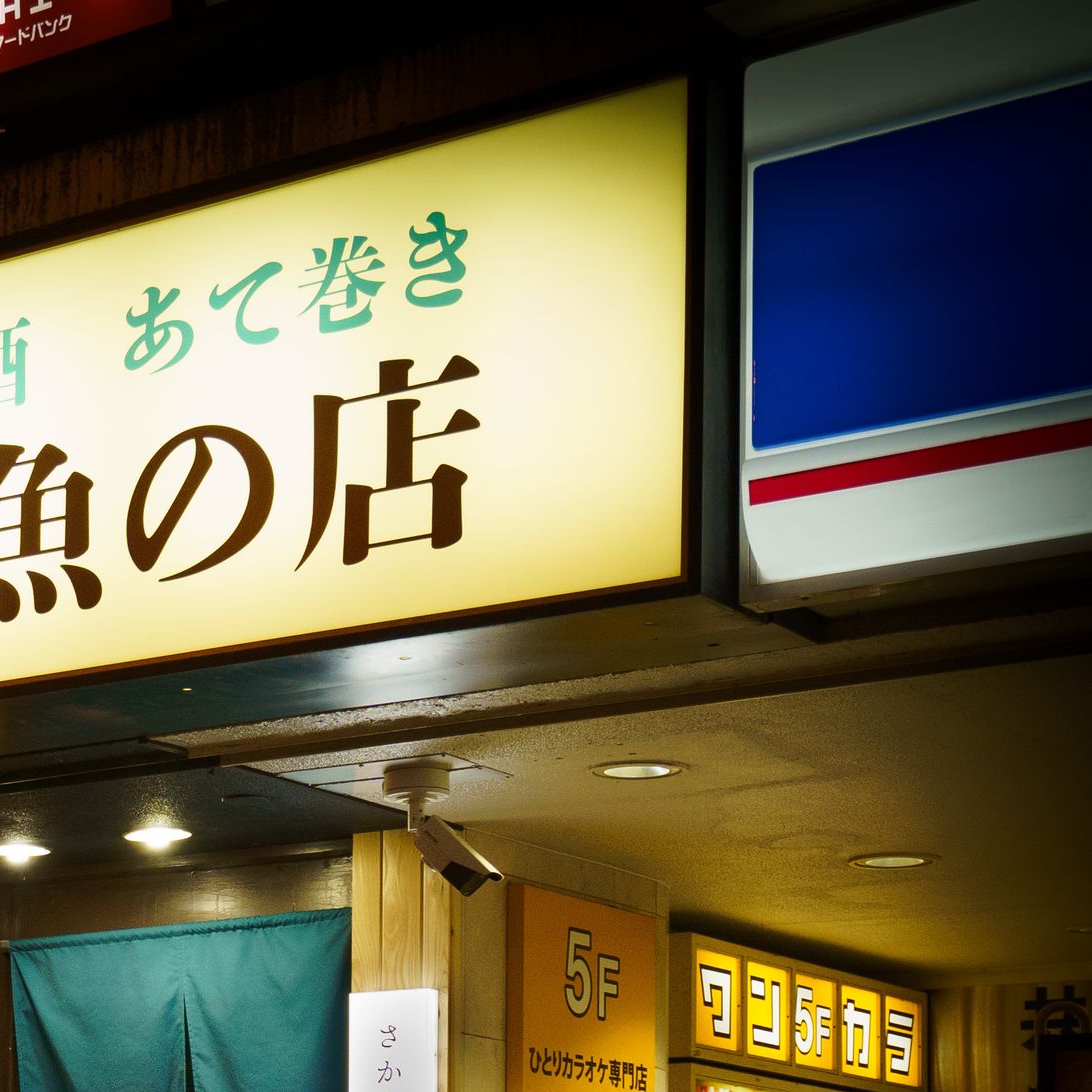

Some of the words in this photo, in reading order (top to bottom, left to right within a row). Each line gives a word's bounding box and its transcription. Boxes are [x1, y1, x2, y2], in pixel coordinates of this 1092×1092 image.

[122, 211, 469, 375] あて巻き
[563, 927, 622, 1022] 5F
[528, 1046, 649, 1092] ひとりカラオケ専門店
